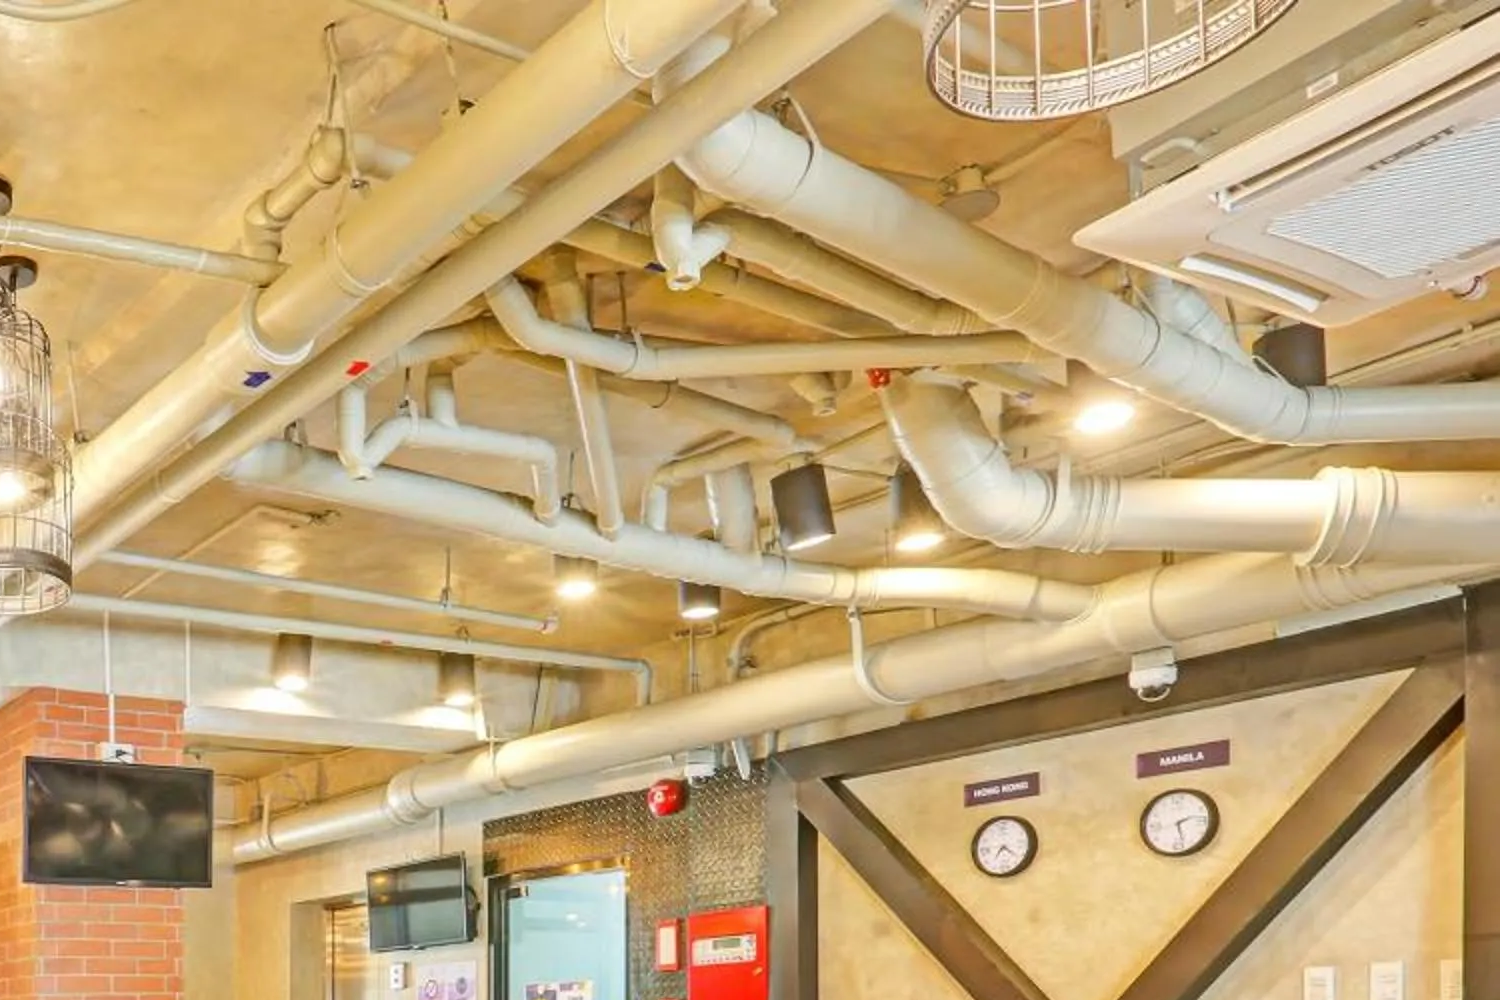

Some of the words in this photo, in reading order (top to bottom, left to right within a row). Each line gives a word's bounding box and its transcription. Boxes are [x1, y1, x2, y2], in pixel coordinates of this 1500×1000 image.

[1159, 751, 1204, 767] MANILA
[973, 785, 1000, 799] HONG
[1001, 781, 1029, 793] KONG
